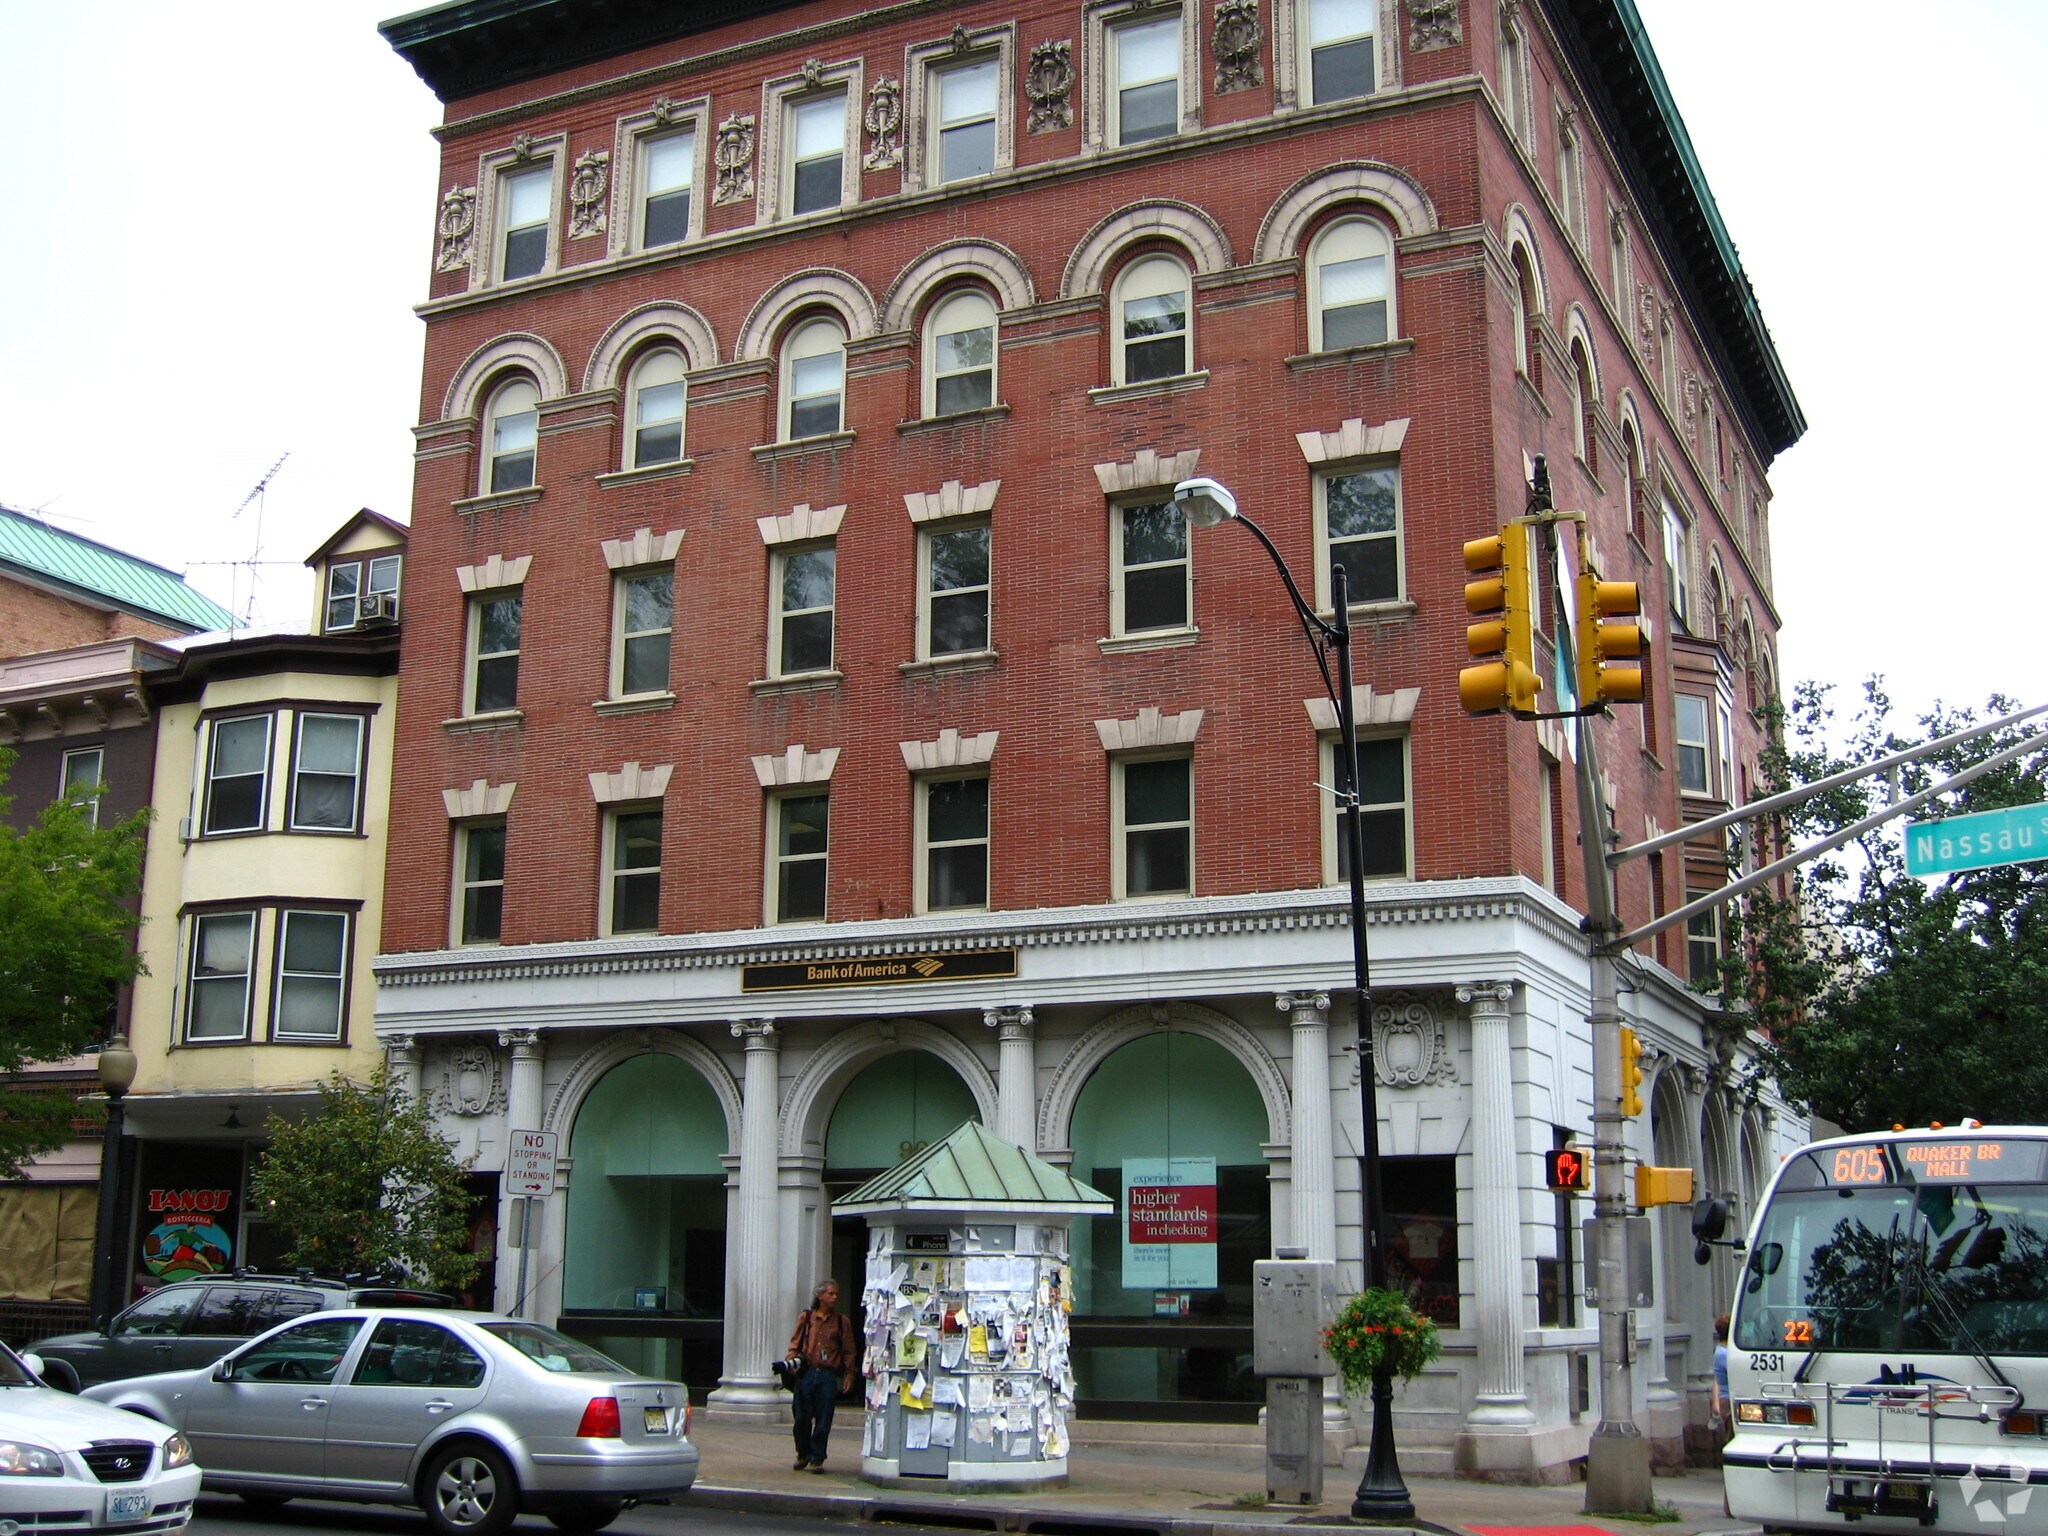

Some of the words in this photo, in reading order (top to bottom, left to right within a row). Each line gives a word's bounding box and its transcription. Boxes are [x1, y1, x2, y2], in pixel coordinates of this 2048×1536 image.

[1917, 826, 2032, 863] Nassau
[807, 965, 839, 980] Bank
[840, 964, 853, 978] of
[854, 962, 906, 977] America
[524, 1135, 544, 1148] NO
[515, 1150, 551, 1160] STOPPING
[527, 1161, 537, 1169] OR
[1833, 1148, 1884, 1182] 605
[1906, 1145, 1972, 1162] QUAKER
[1976, 1144, 2002, 1160] BR
[1926, 1161, 1969, 1177] MALL
[513, 1170, 550, 1180] STANDING
[1133, 1174, 1183, 1184] experience
[1132, 1189, 1180, 1207] higher
[167, 1215, 211, 1225] ROSTICCERIA
[1132, 1206, 1208, 1222] standards
[1147, 1224, 1158, 1235] in
[1158, 1223, 1208, 1237] checking
[922, 1240, 946, 1249] Phone
[1784, 1321, 1810, 1341] 22
[1750, 1353, 1784, 1372] 2531
[1886, 1407, 1920, 1416] TRANSIT
